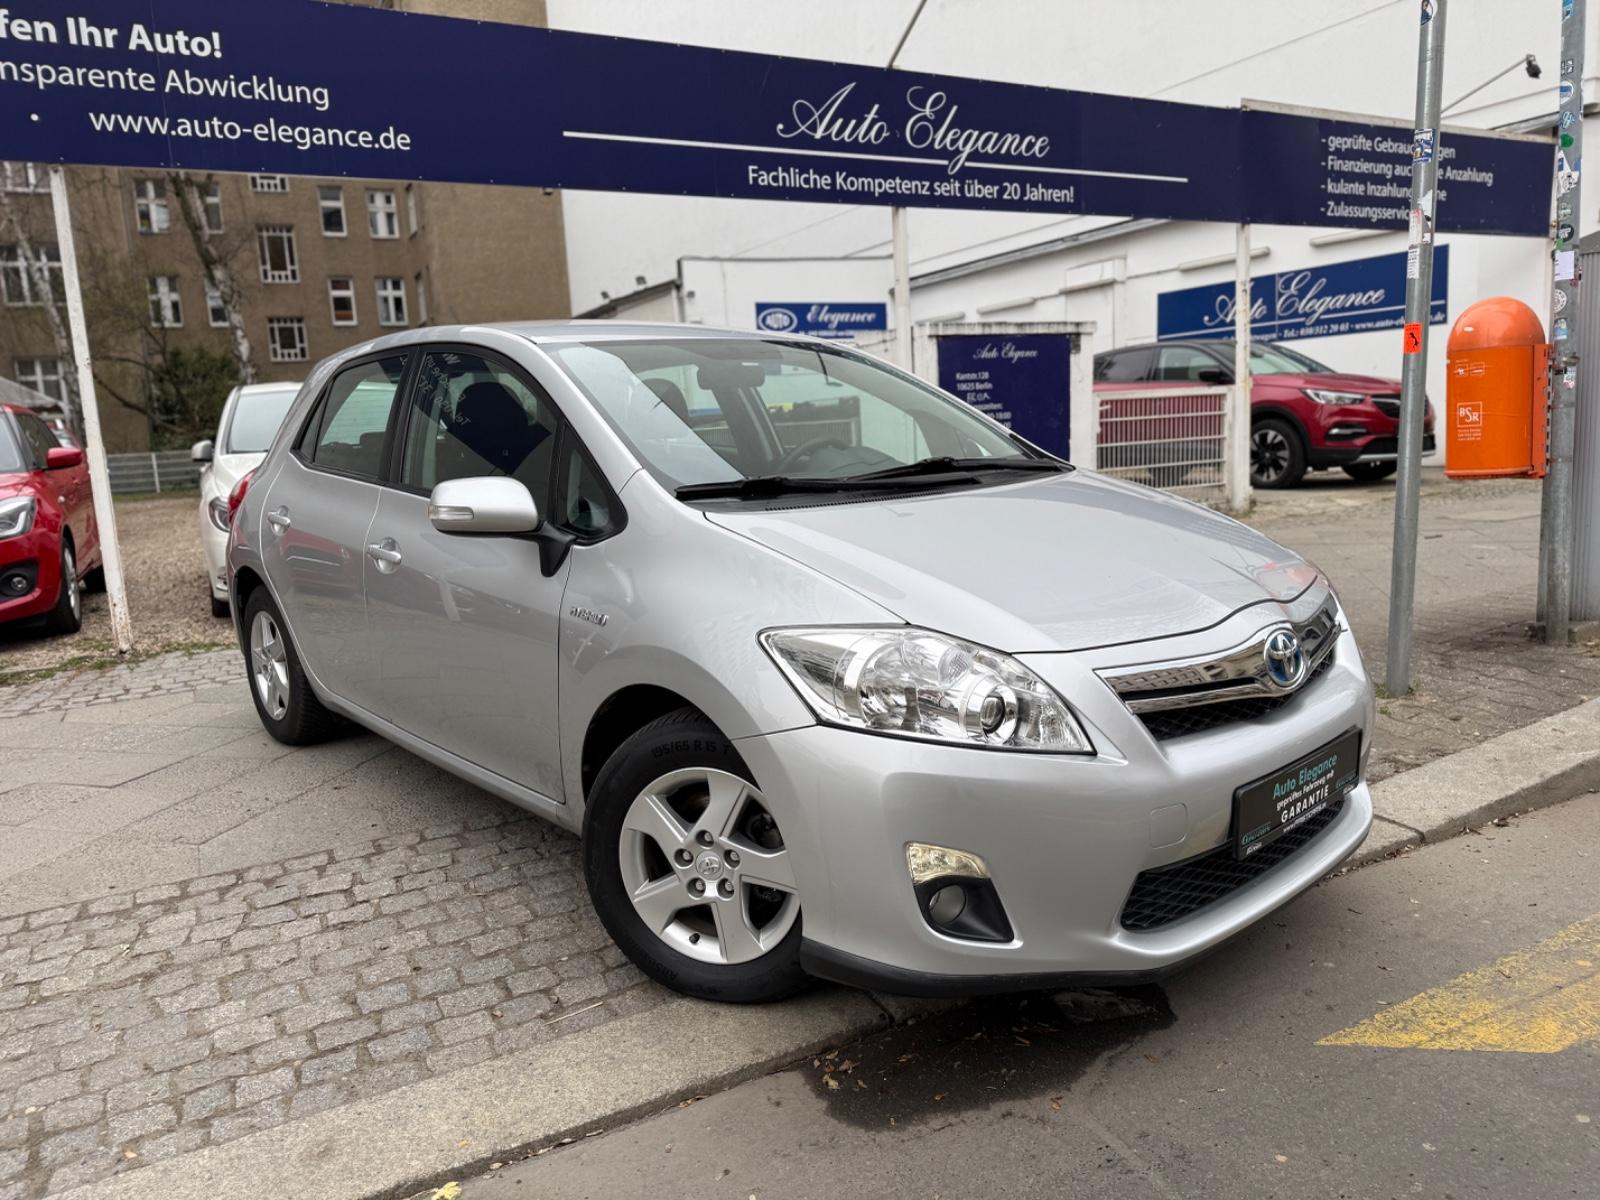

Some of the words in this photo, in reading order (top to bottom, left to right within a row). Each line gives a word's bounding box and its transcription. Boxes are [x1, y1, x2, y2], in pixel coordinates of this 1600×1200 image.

[0, 8, 57, 43] fen
[67, 16, 118, 48] Ihr
[129, 24, 222, 58] Auto!
[0, 60, 155, 90] nsparente
[165, 69, 329, 110] Abwicklung
[89, 112, 411, 150] www.auto-elegance.de
[776, 82, 890, 144] Auto
[905, 85, 1050, 174] Elegance
[1327, 135, 1372, 152] geprüfte
[748, 165, 832, 190] Fachliche
[835, 171, 931, 197] Kompetenz
[933, 178, 961, 197] seit
[964, 179, 1000, 199] über
[1002, 182, 1021, 200] 20
[1023, 183, 1075, 203] Jahren!
[1327, 155, 1392, 179] Finanzierung
[1394, 164, 1413, 177] auc
[1445, 166, 1493, 187] Anzahlung
[1327, 178, 1365, 196] kulante
[806, 304, 877, 329] Elegance
[1276, 271, 1385, 325] Elegance
[972, 343, 999, 359] Auto
[1001, 342, 1039, 363] Elegance
[1459, 406, 1480, 423] BSR
[652, 740, 690, 758] 195/65
[694, 737, 703, 752] R
[706, 738, 718, 753] 15
[1273, 778, 1296, 800] Auto
[1299, 755, 1338, 786] Elegance
[1281, 784, 1329, 823] GARANTIE
